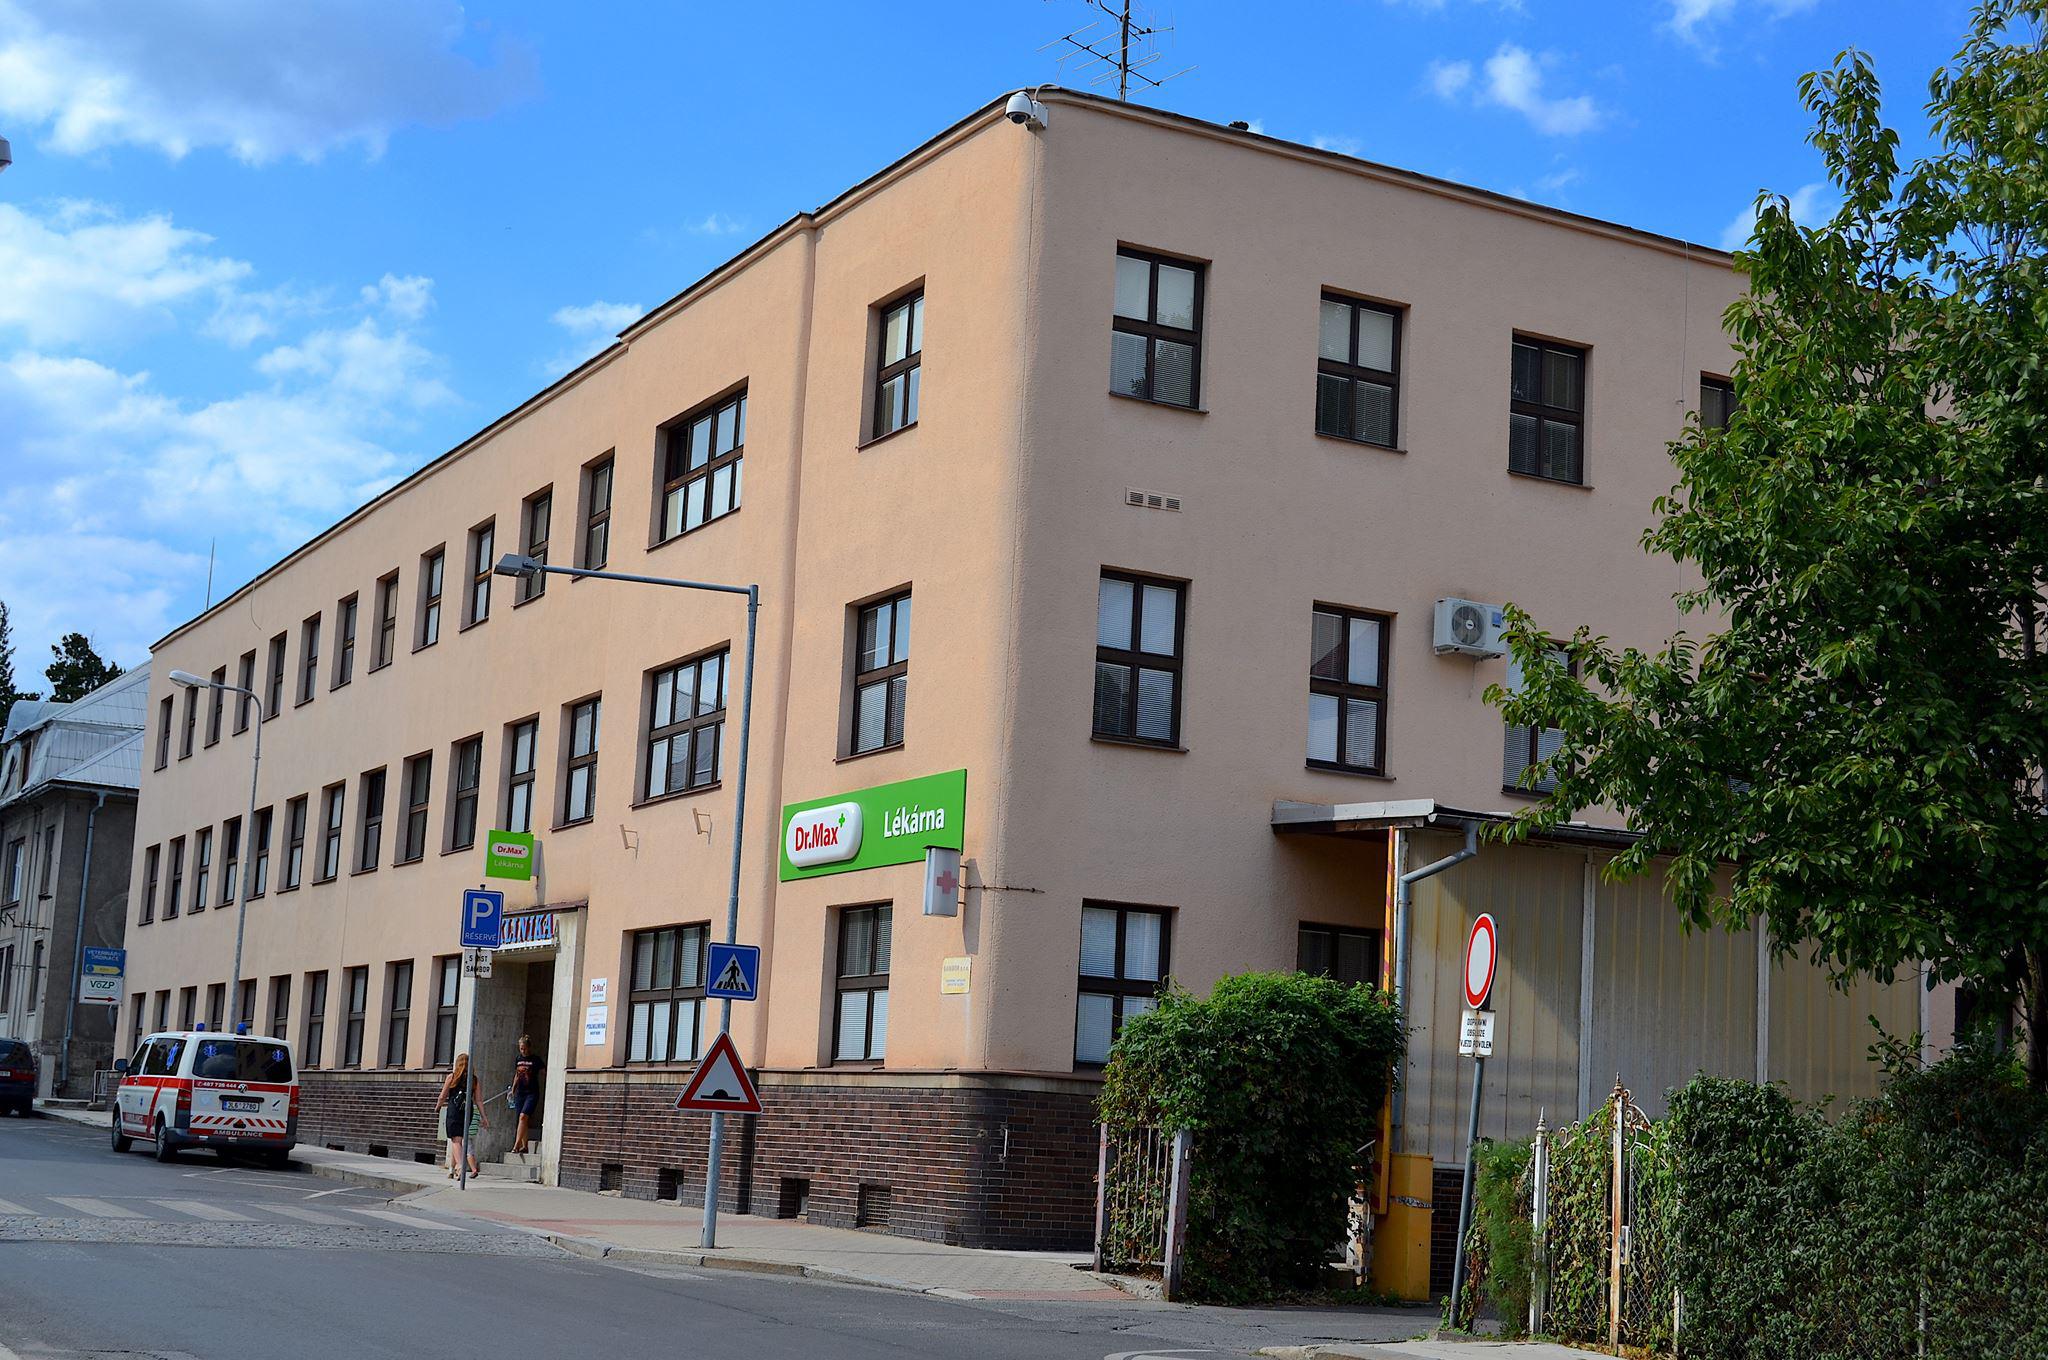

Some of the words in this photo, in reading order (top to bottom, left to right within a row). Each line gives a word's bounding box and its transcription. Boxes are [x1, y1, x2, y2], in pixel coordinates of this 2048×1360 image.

[883, 804, 945, 838] Lékárna
[795, 822, 839, 851] Dr.Max
[497, 845, 523, 855] Dr.Max
[470, 897, 494, 929] P
[464, 931, 497, 941] RÉSERVÉ
[465, 965, 491, 973] SABOR
[213, 1129, 263, 1138] AMBULANCE
